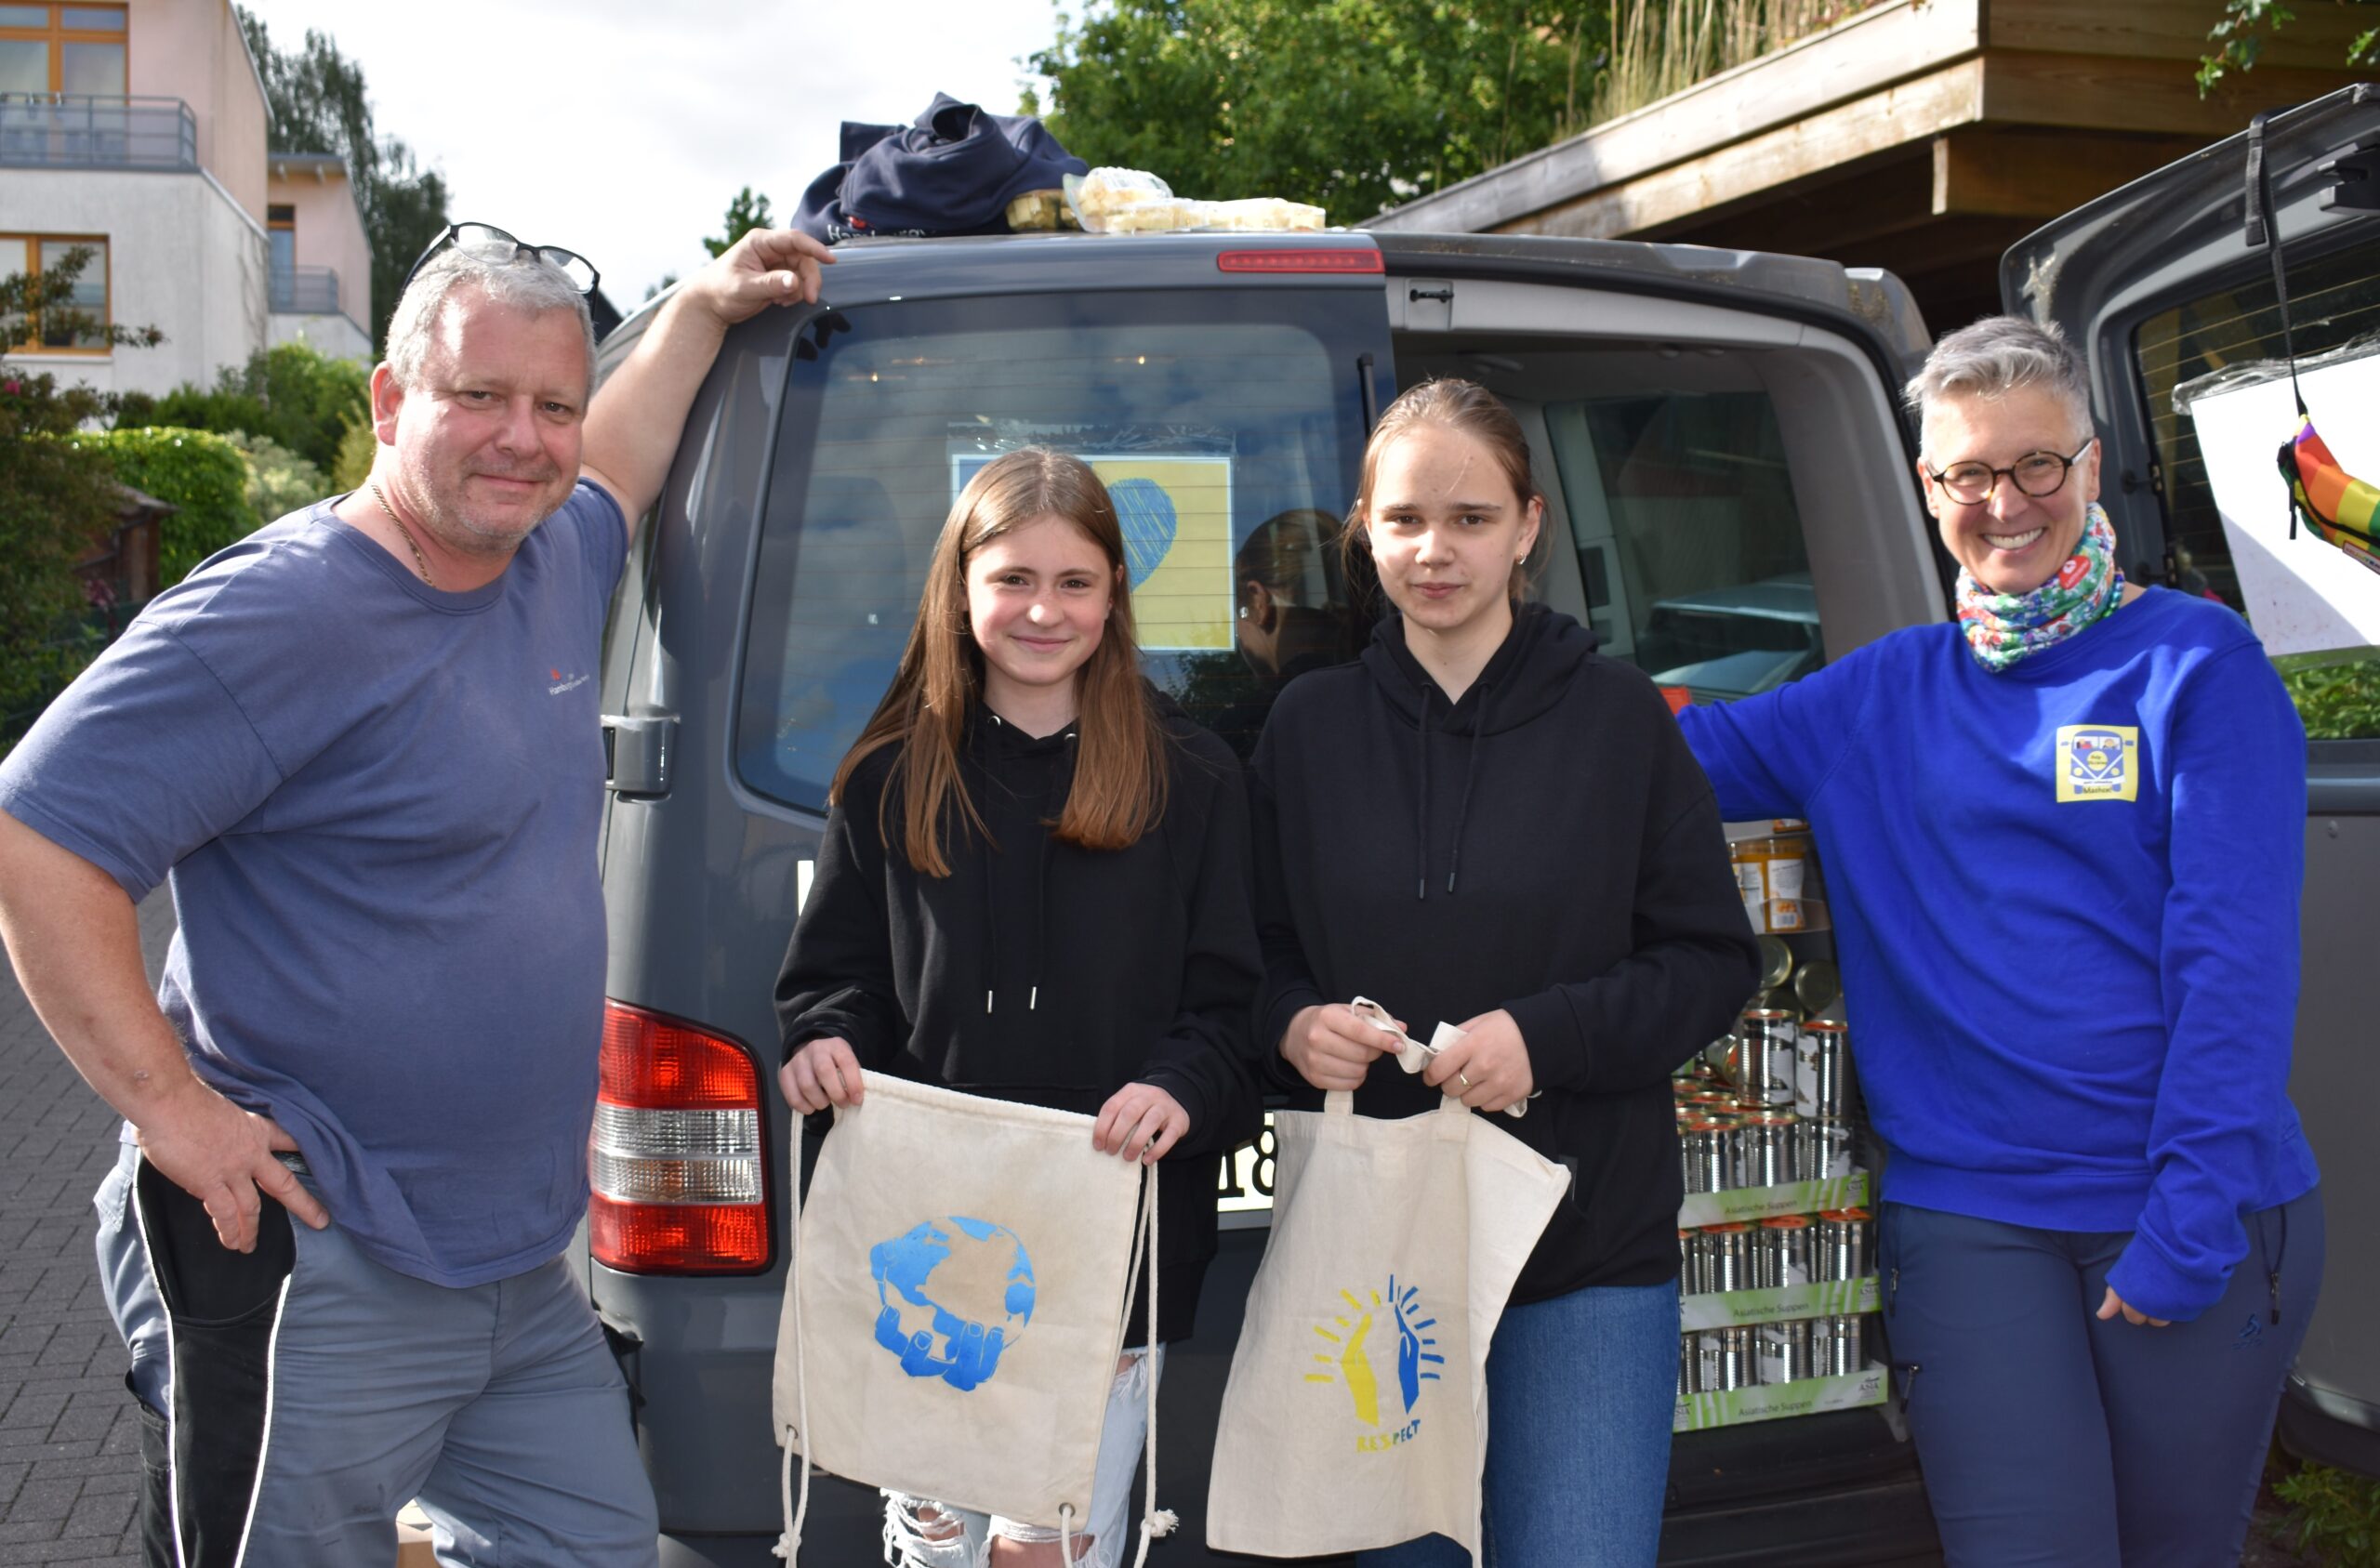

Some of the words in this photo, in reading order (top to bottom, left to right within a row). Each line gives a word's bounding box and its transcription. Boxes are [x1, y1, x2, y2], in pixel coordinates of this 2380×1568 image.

[1733, 1307, 1775, 1318] Asiatische
[1777, 1302, 1809, 1313] Suppen
[1738, 1405, 1779, 1416] Asiatische
[1780, 1400, 1813, 1412] Suppen
